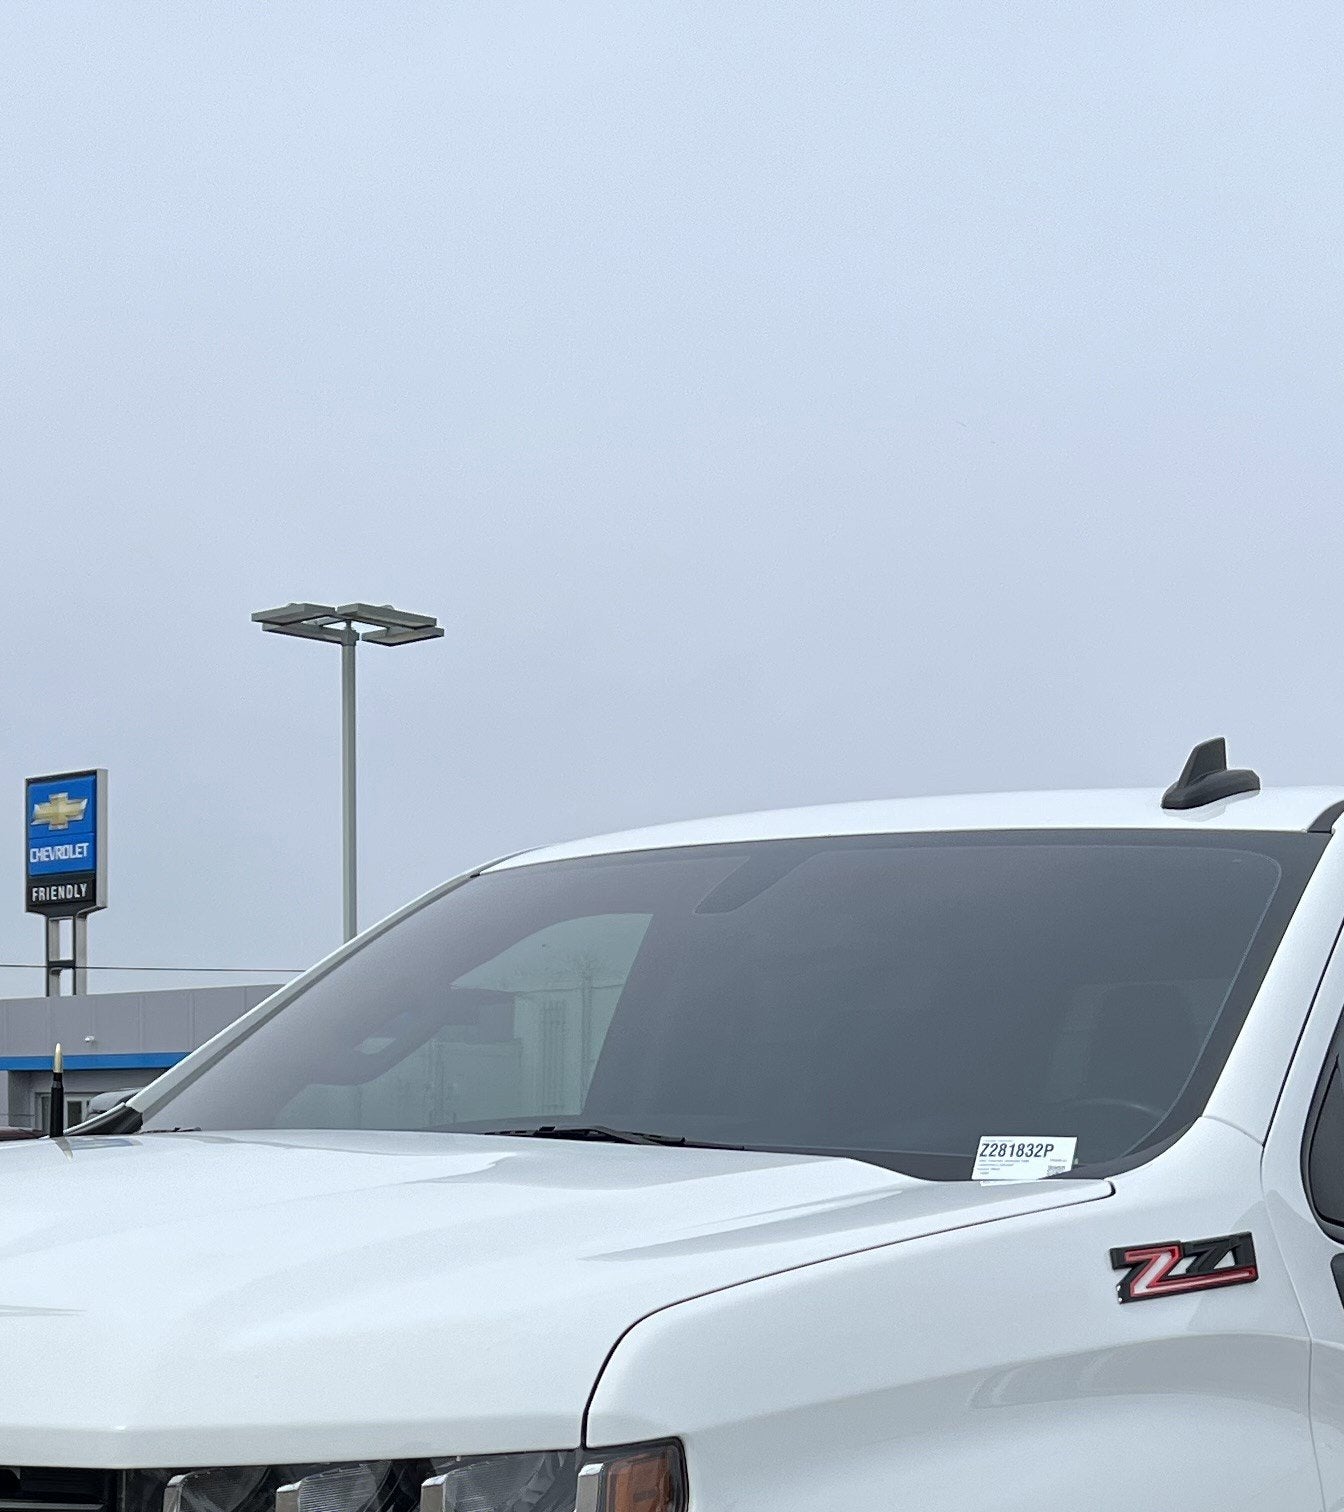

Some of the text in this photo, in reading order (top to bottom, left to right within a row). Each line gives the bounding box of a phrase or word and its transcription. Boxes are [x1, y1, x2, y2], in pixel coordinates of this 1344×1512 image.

[29, 842, 89, 863] CHEVROLET
[31, 883, 88, 902] FRIENDLY
[979, 1143, 1054, 1158] Z281832P
[1109, 1231, 1259, 1304] Z71
